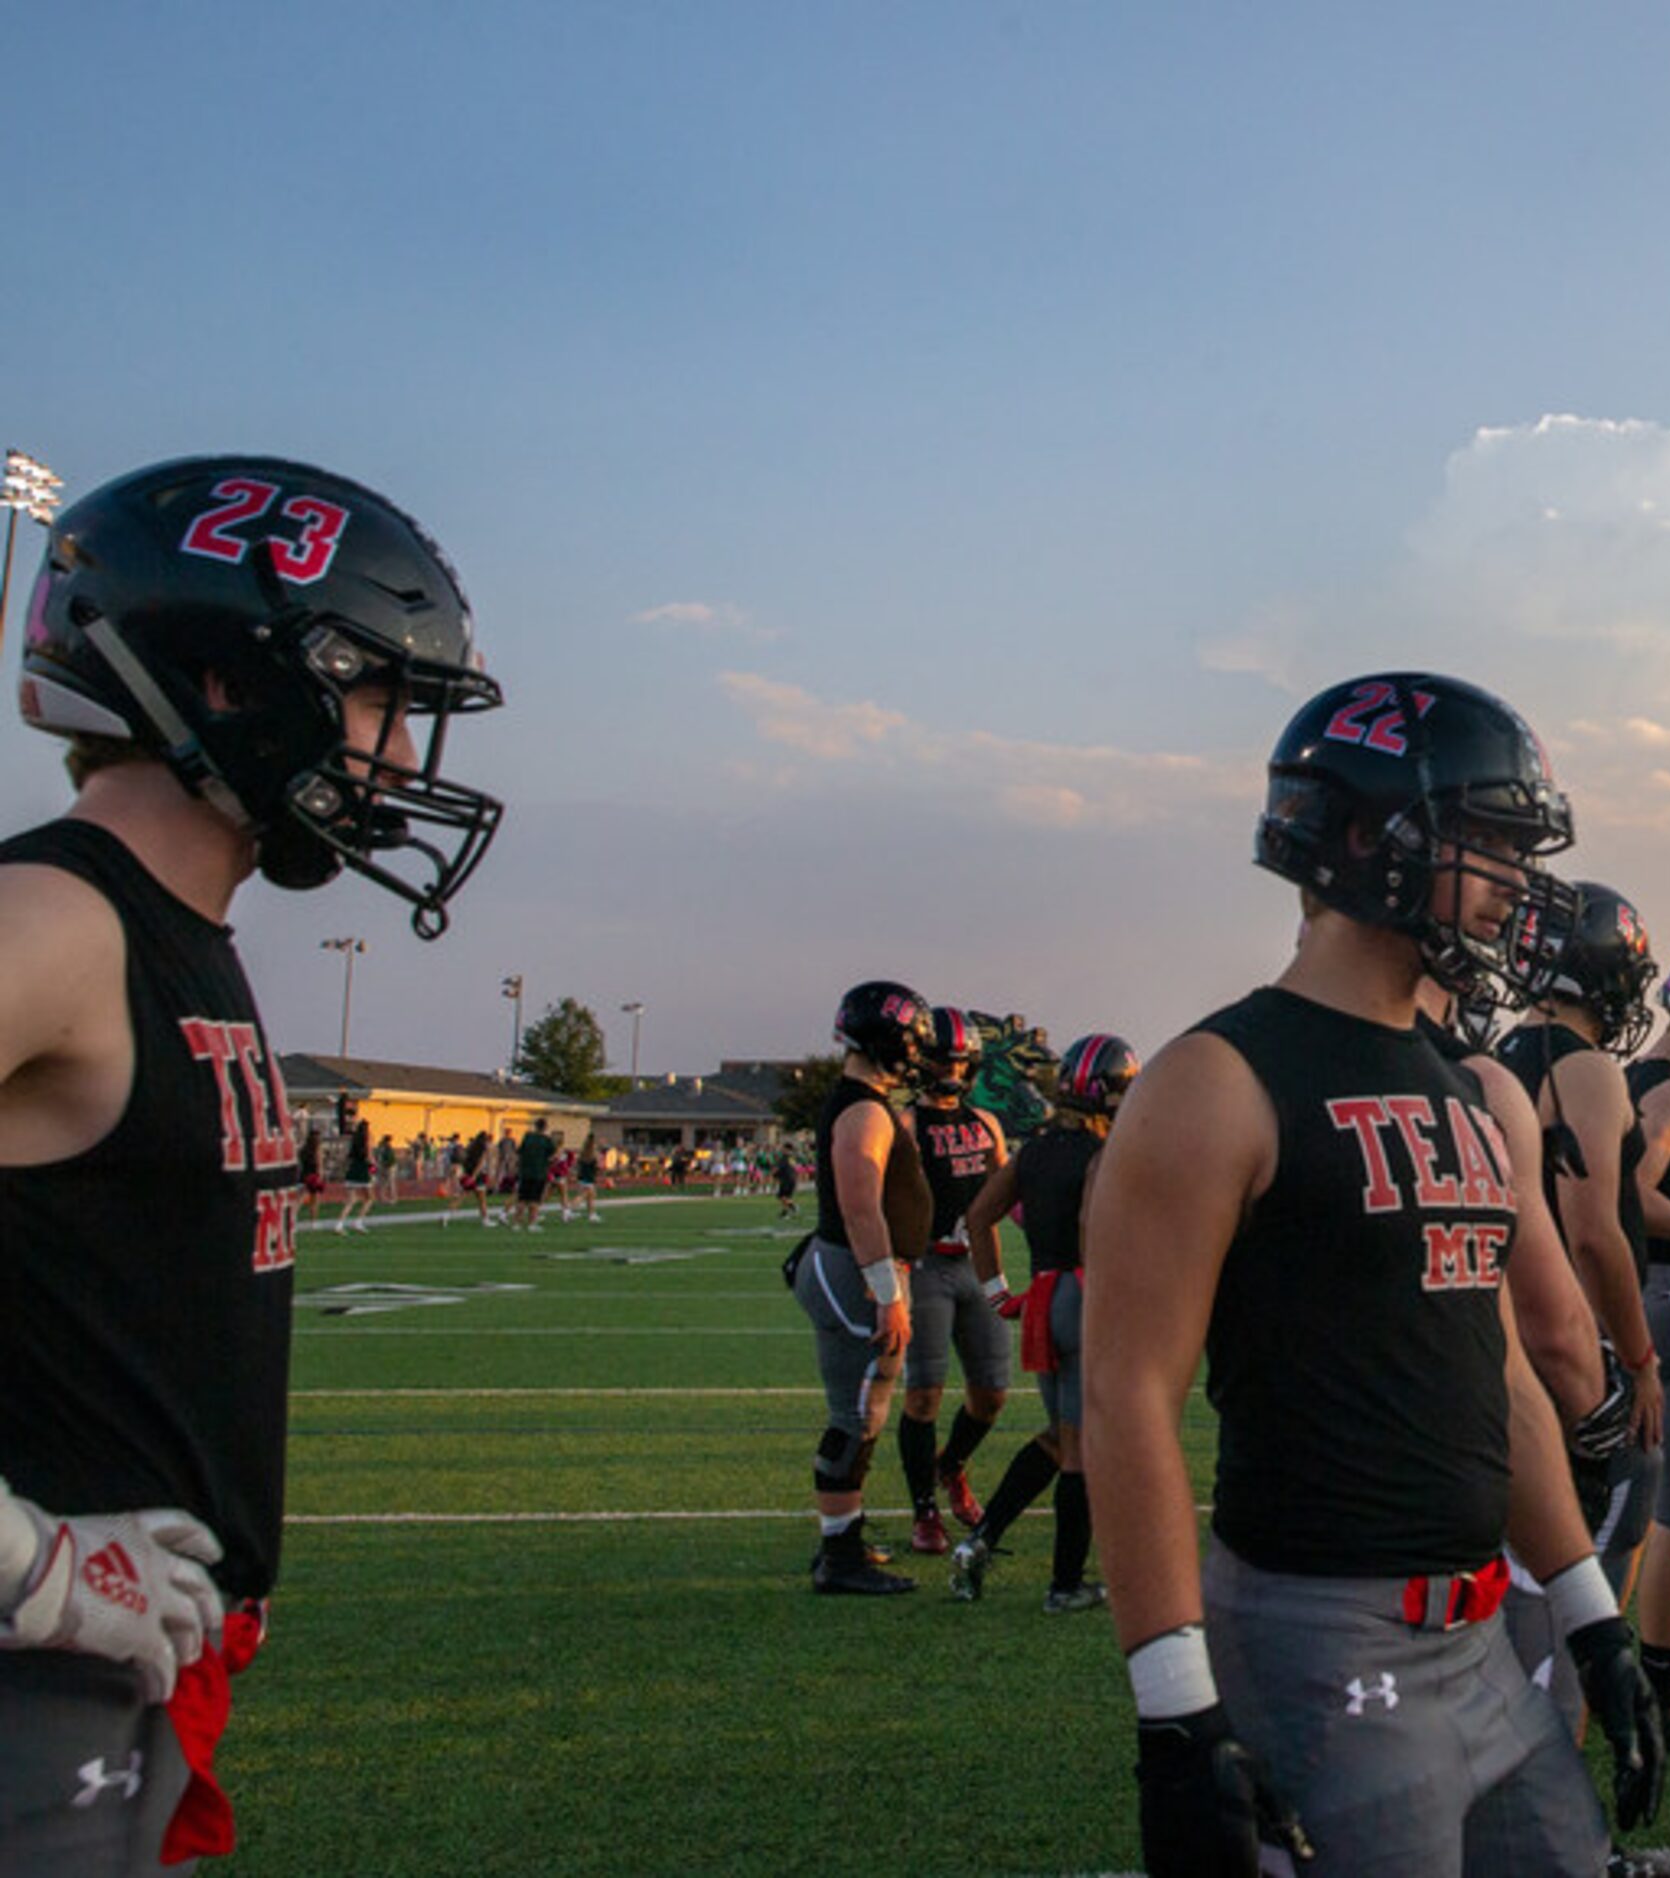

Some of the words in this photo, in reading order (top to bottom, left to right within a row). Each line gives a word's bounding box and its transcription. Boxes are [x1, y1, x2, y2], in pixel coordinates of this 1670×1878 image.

[180, 477, 350, 585] 23
[1323, 681, 1436, 757] 22
[1421, 1222, 1508, 1291] ME
